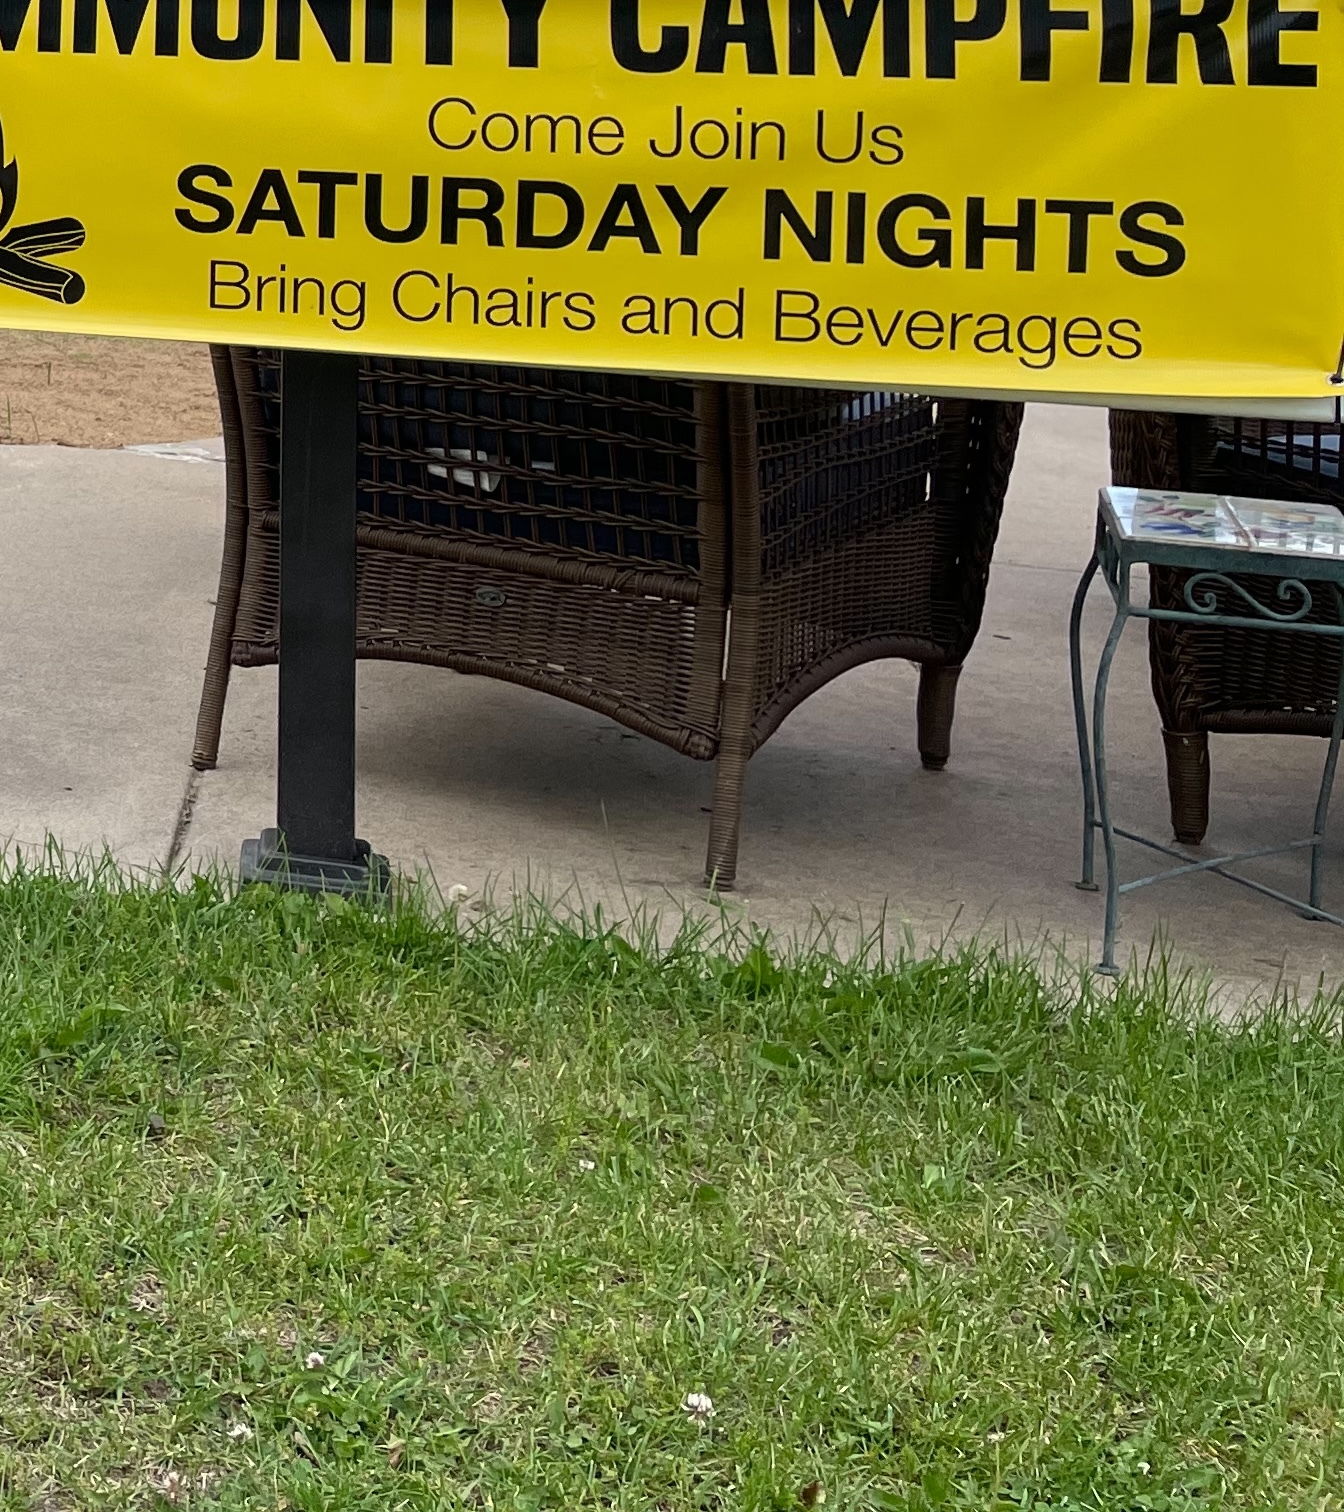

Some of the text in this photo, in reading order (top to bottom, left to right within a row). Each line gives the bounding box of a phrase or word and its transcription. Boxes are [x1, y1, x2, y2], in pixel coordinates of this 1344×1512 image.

[428, 97, 904, 166] Come Join Us
[175, 164, 1186, 278] SATURDAY NIGHTS
[209, 259, 1142, 370] Bring Chairs and Beverages
